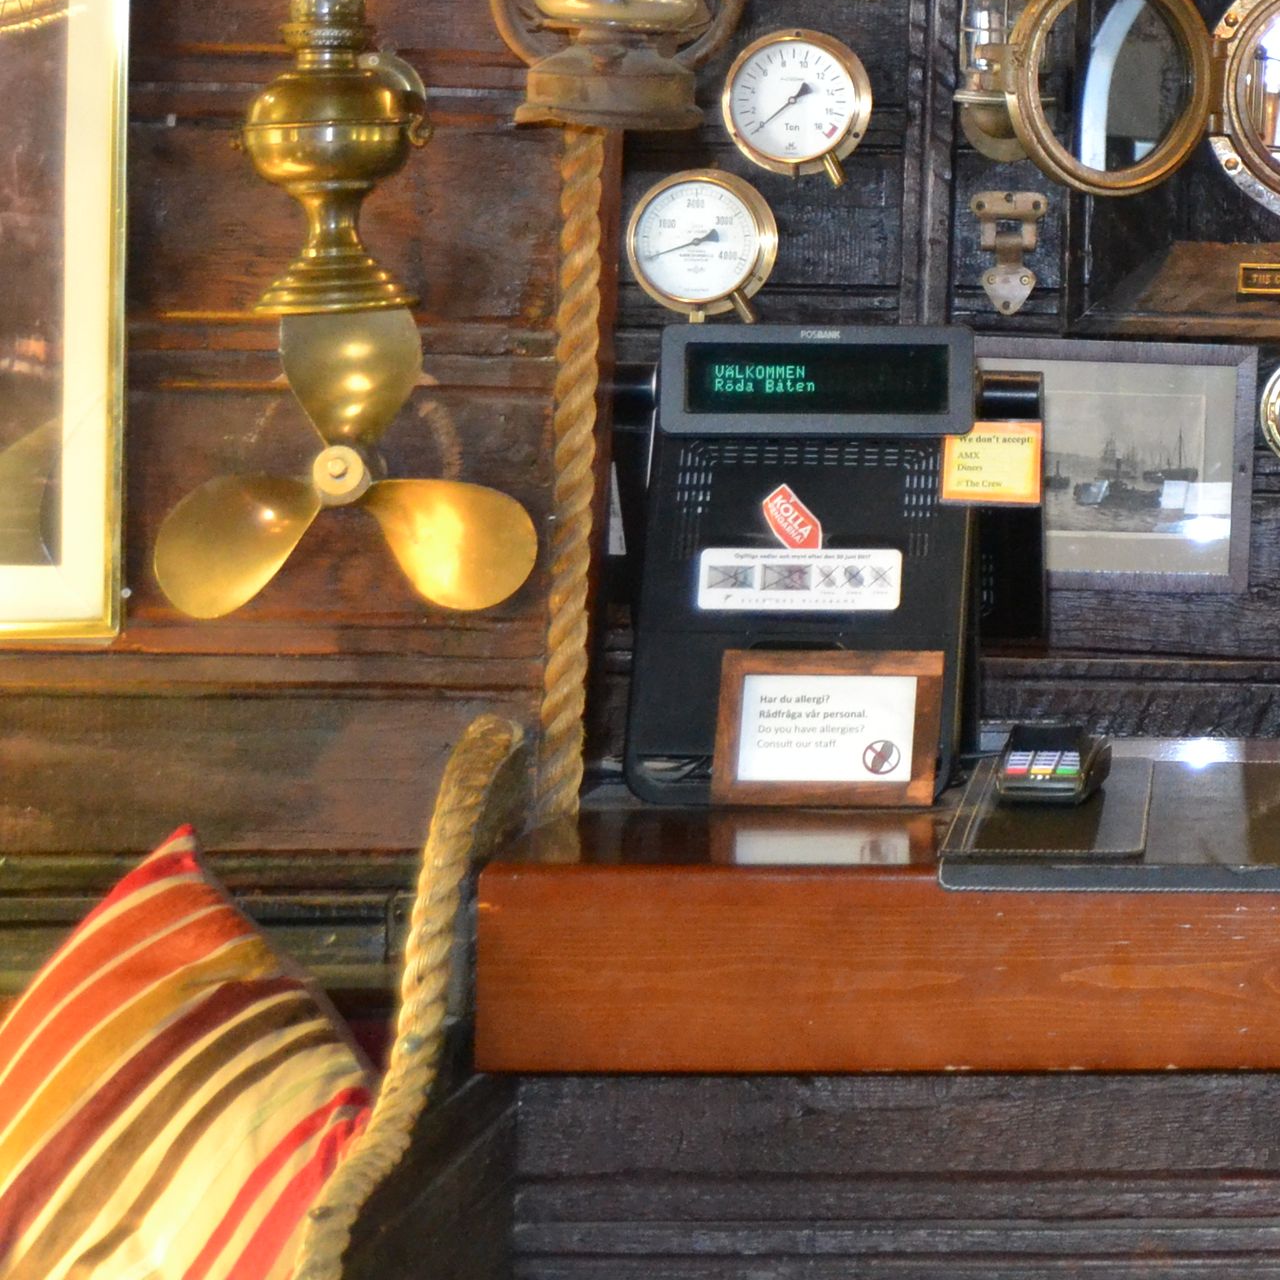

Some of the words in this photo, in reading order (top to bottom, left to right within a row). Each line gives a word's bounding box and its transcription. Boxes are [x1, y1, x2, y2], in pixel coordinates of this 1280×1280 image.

[800, 330, 840, 339] POSBANK
[715, 365, 806, 379] VÄLKOMMEN
[715, 379, 754, 393] Röda
[765, 379, 815, 393] Båten
[975, 435, 999, 444] don't
[957, 452, 980, 460] AMX
[957, 464, 983, 472] Diners
[982, 480, 1002, 488] Crew
[773, 494, 813, 539] KOLLA
[760, 695, 777, 703] Har
[780, 695, 792, 703] du
[795, 695, 830, 706] allergi?
[759, 710, 802, 721] Rådfråga
[805, 710, 820, 719] vår
[823, 710, 868, 720] personal.
[758, 724, 771, 733] Do
[774, 725, 792, 735] you
[794, 724, 817, 733] have
[820, 724, 865, 735] allergies?
[757, 739, 792, 748] Consult
[795, 740, 812, 748] our
[815, 739, 837, 748] staff
